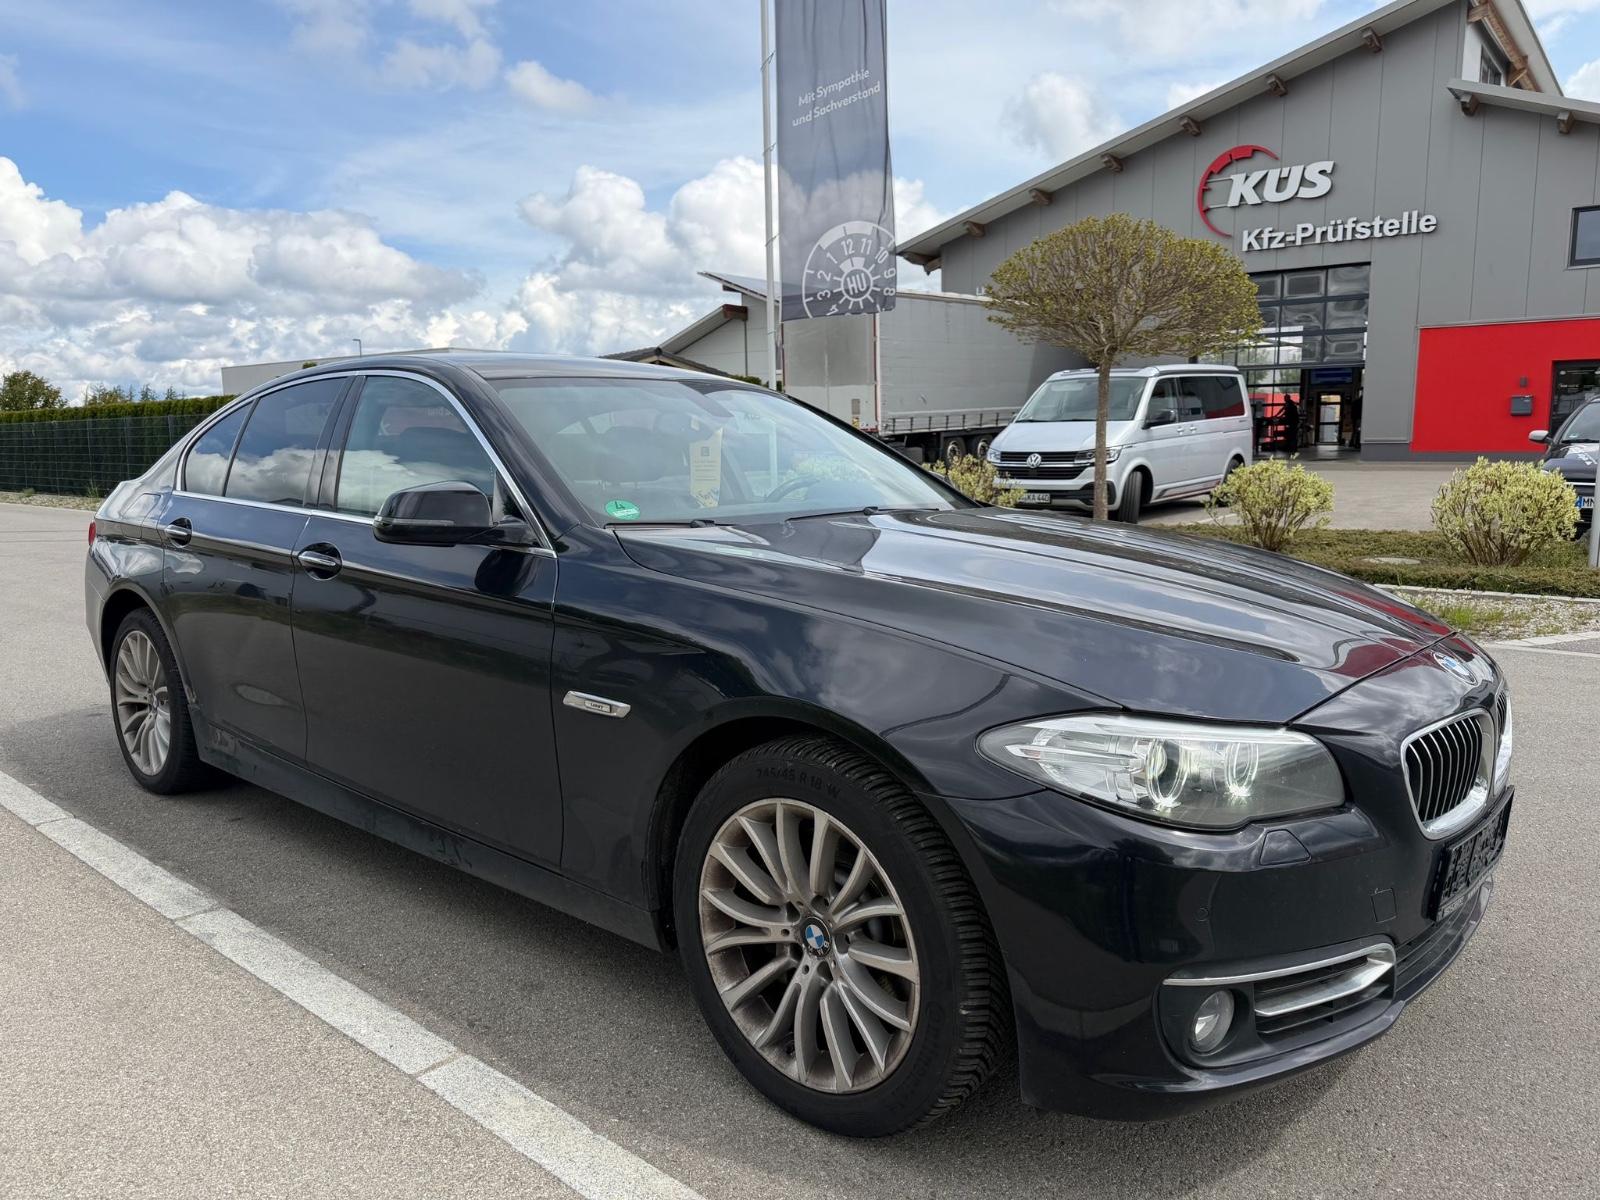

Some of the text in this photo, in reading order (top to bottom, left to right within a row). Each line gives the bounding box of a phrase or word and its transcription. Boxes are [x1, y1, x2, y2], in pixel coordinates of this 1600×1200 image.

[798, 68, 870, 107] Mit Sympathie
[792, 80, 881, 127] und Sachverstand
[1226, 160, 1335, 208] KÜS
[1241, 209, 1438, 252] Kfz-Prüfstelle
[841, 238, 855, 256] 12
[860, 238, 873, 255] 11
[874, 246, 889, 264] 10
[826, 252, 838, 264] 1
[817, 270, 832, 282] 2
[846, 273, 867, 295] HU
[817, 289, 831, 300] 3
[883, 287, 896, 296] 8
[614, 500, 626, 510] 4
[799, 771, 808, 784] R
[810, 775, 823, 790] 18
